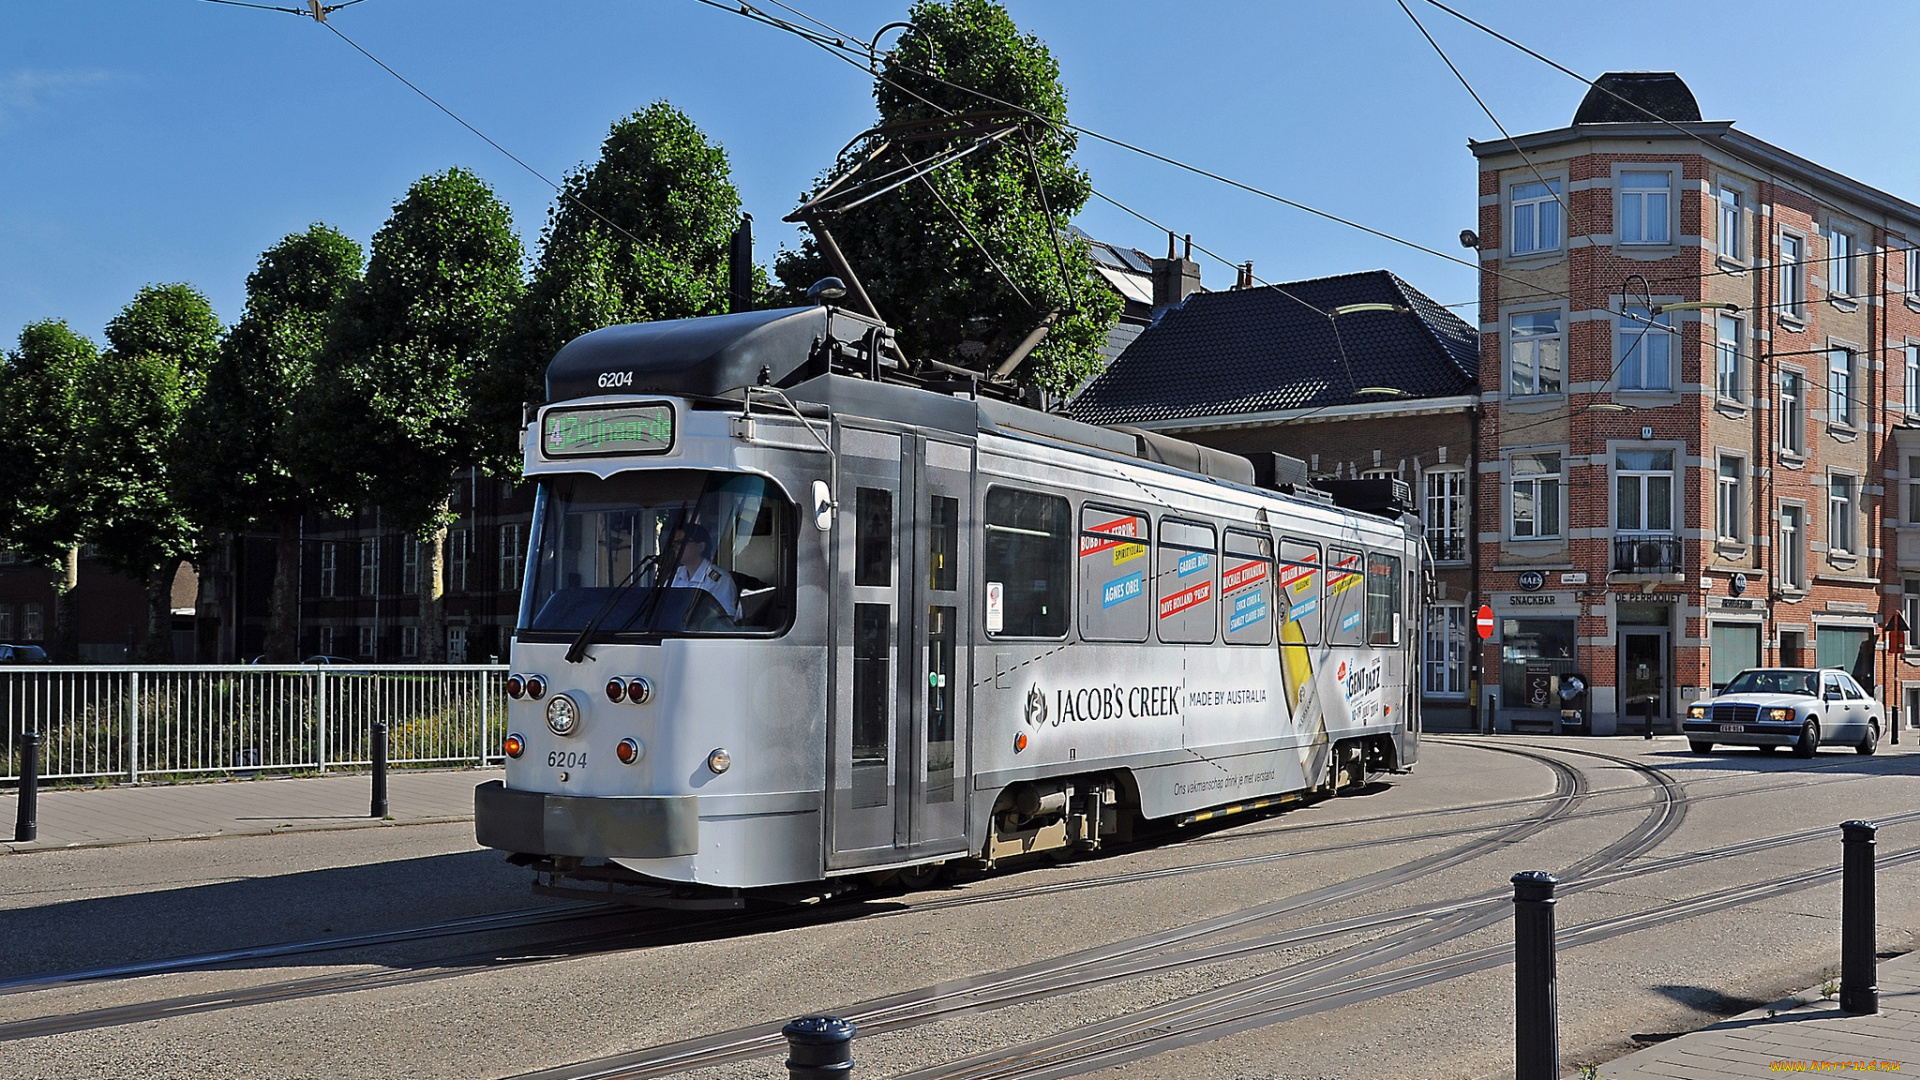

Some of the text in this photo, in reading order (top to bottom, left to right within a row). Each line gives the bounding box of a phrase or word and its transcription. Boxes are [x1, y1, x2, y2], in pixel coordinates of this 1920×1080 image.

[597, 371, 633, 388] 6204
[1180, 558, 1197, 574] GABRIEL
[1520, 576, 1543, 585] MAES
[1104, 578, 1140, 603] AGNES OBEL
[1615, 593, 1682, 604] DE PERROQUET
[1161, 601, 1173, 615] DAVE
[1173, 593, 1193, 609] HOLLAND
[1509, 595, 1556, 606] SNACKBAR
[1348, 665, 1381, 697] GENT JAZZ
[1051, 683, 1267, 727] JACOB'S CREEK MADE BY AUSTRALIA
[548, 751, 587, 769] 6204
[1174, 782, 1186, 796] Ons
